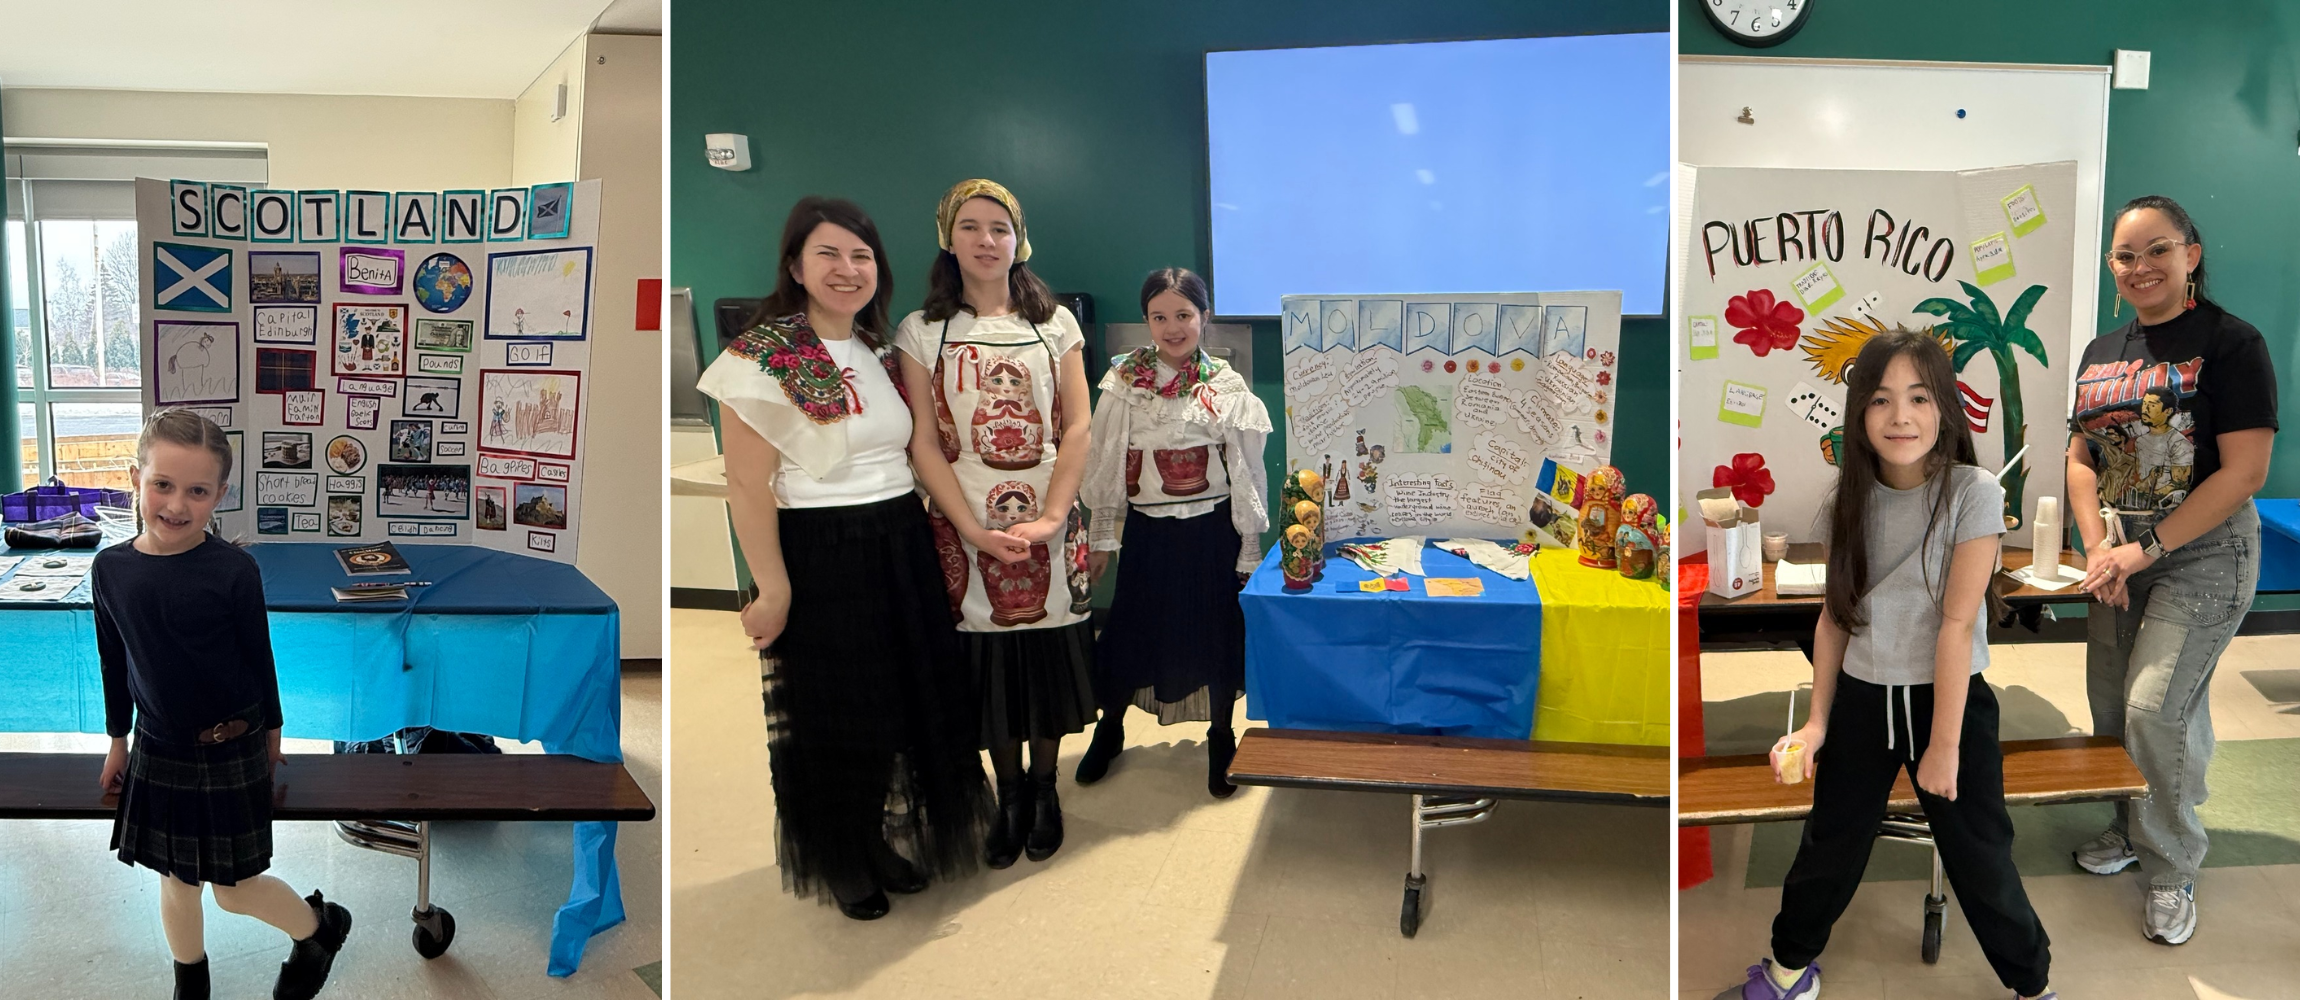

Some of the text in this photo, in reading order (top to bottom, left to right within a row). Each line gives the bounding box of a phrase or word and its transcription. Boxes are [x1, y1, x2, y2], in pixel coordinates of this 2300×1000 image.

[1730, 10, 1740, 26] 7
[1751, 16, 1761, 32] 6
[179, 189, 521, 237] SCOTLAND
[1701, 208, 1955, 283] PUERTO RICO
[259, 324, 313, 337] Edinburgh
[1290, 309, 1570, 339] MOLDOVA
[2077, 361, 2129, 383] BAD
[1520, 398, 1527, 408] 4
[1508, 464, 1520, 473] of
[258, 474, 290, 492] Short
[1389, 479, 1431, 489] Interesting
[295, 514, 318, 529] Tea
